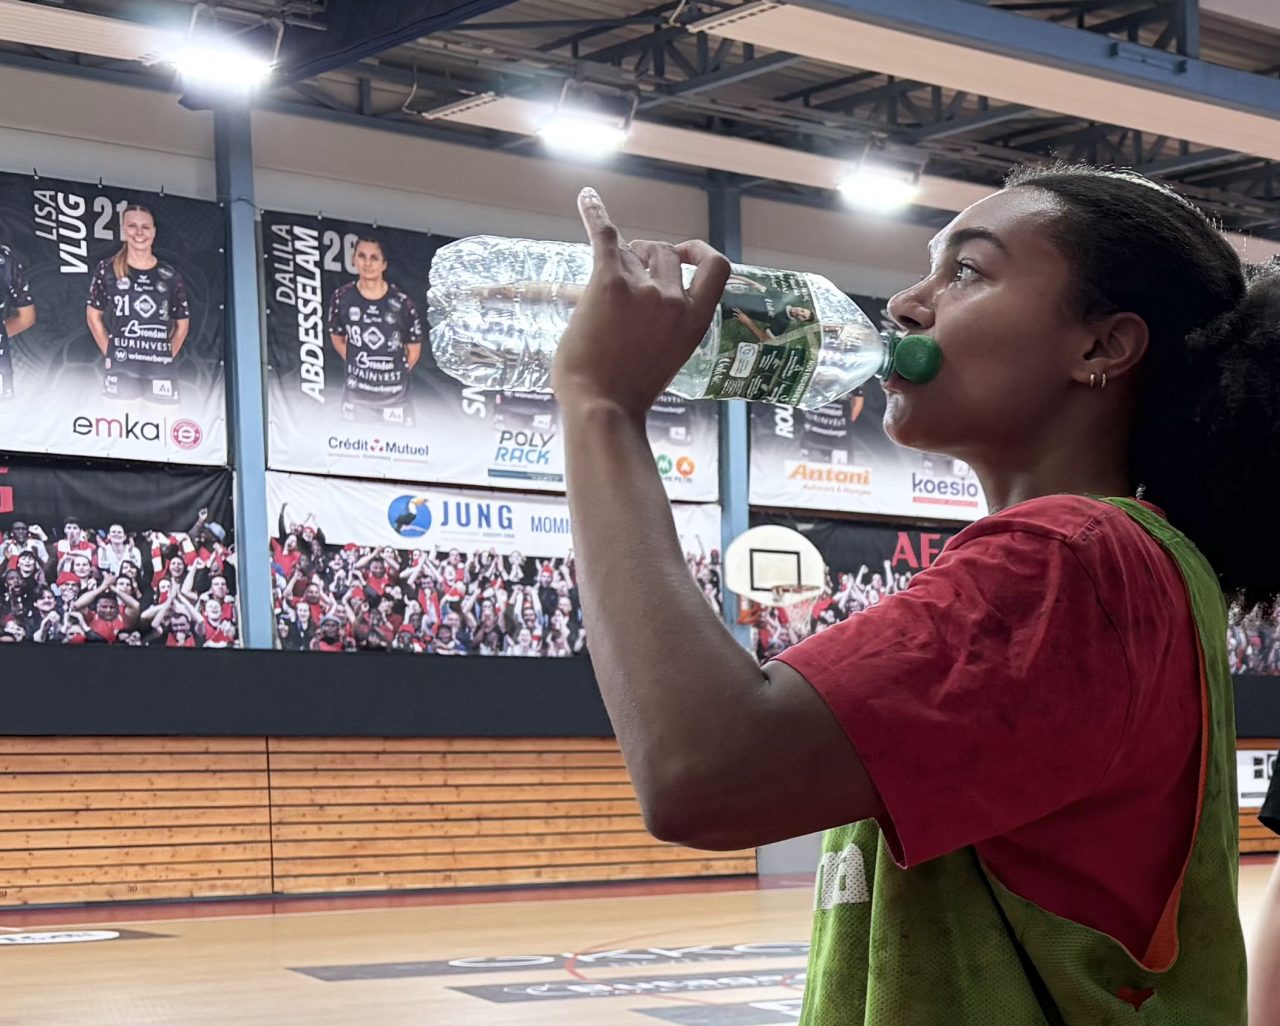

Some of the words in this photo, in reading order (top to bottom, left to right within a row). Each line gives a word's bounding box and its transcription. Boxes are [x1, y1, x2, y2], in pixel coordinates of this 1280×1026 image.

[34, 190, 58, 241] LISA
[57, 191, 89, 274] VLUG
[271, 224, 296, 306] DALILA
[114, 294, 130, 316] 21
[292, 225, 326, 404] ABDESSELAM
[114, 338, 172, 352] EURINVEST
[73, 412, 160, 441] emka
[499, 430, 555, 449] POLY
[328, 436, 369, 452] Crédit
[385, 442, 429, 456] Mutuel
[494, 447, 551, 465] RACK
[787, 463, 872, 486] Antoni
[911, 471, 979, 497] koesio
[440, 500, 514, 531] JUNG
